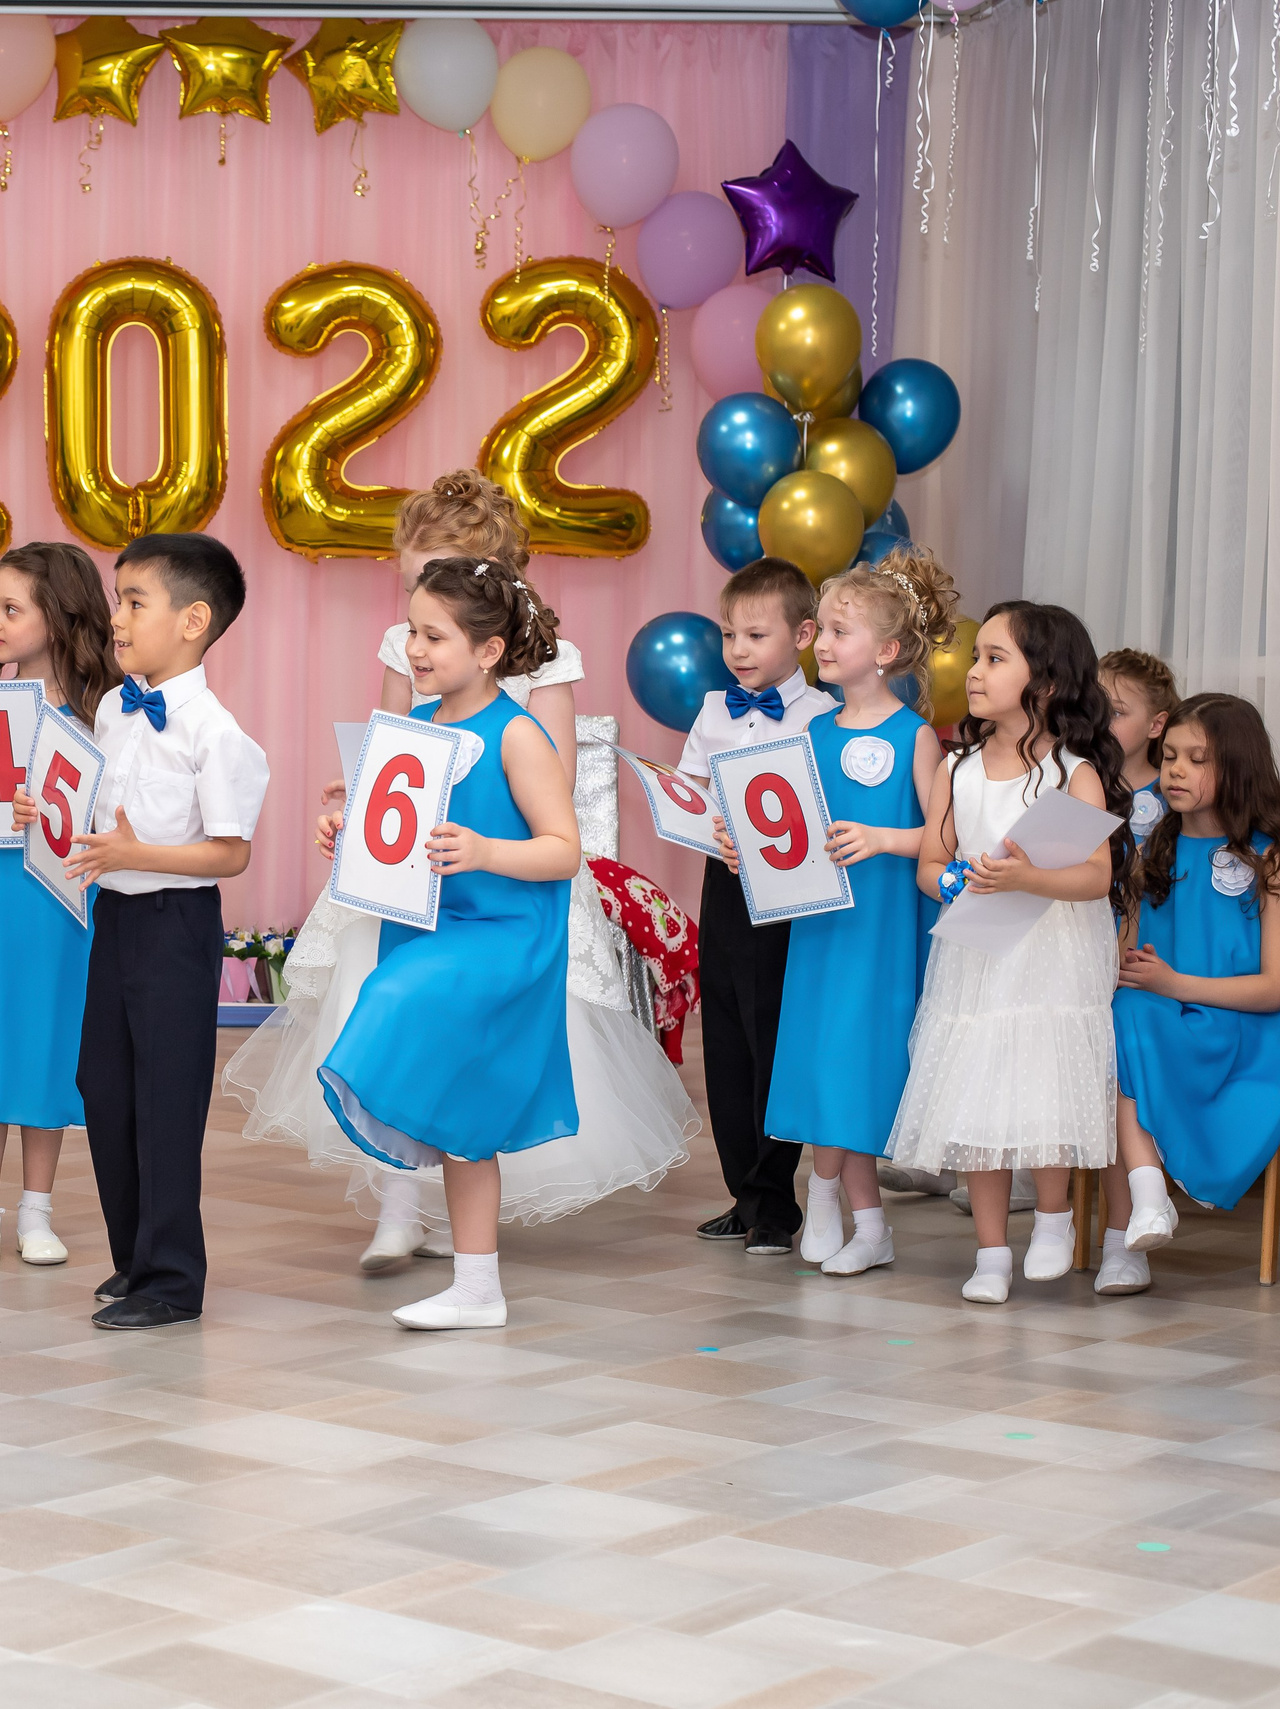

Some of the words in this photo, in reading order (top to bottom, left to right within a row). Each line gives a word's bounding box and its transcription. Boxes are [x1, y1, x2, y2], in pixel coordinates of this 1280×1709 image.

[39, 750, 82, 859] 5
[363, 753, 426, 866] 6
[744, 772, 809, 871] 9
